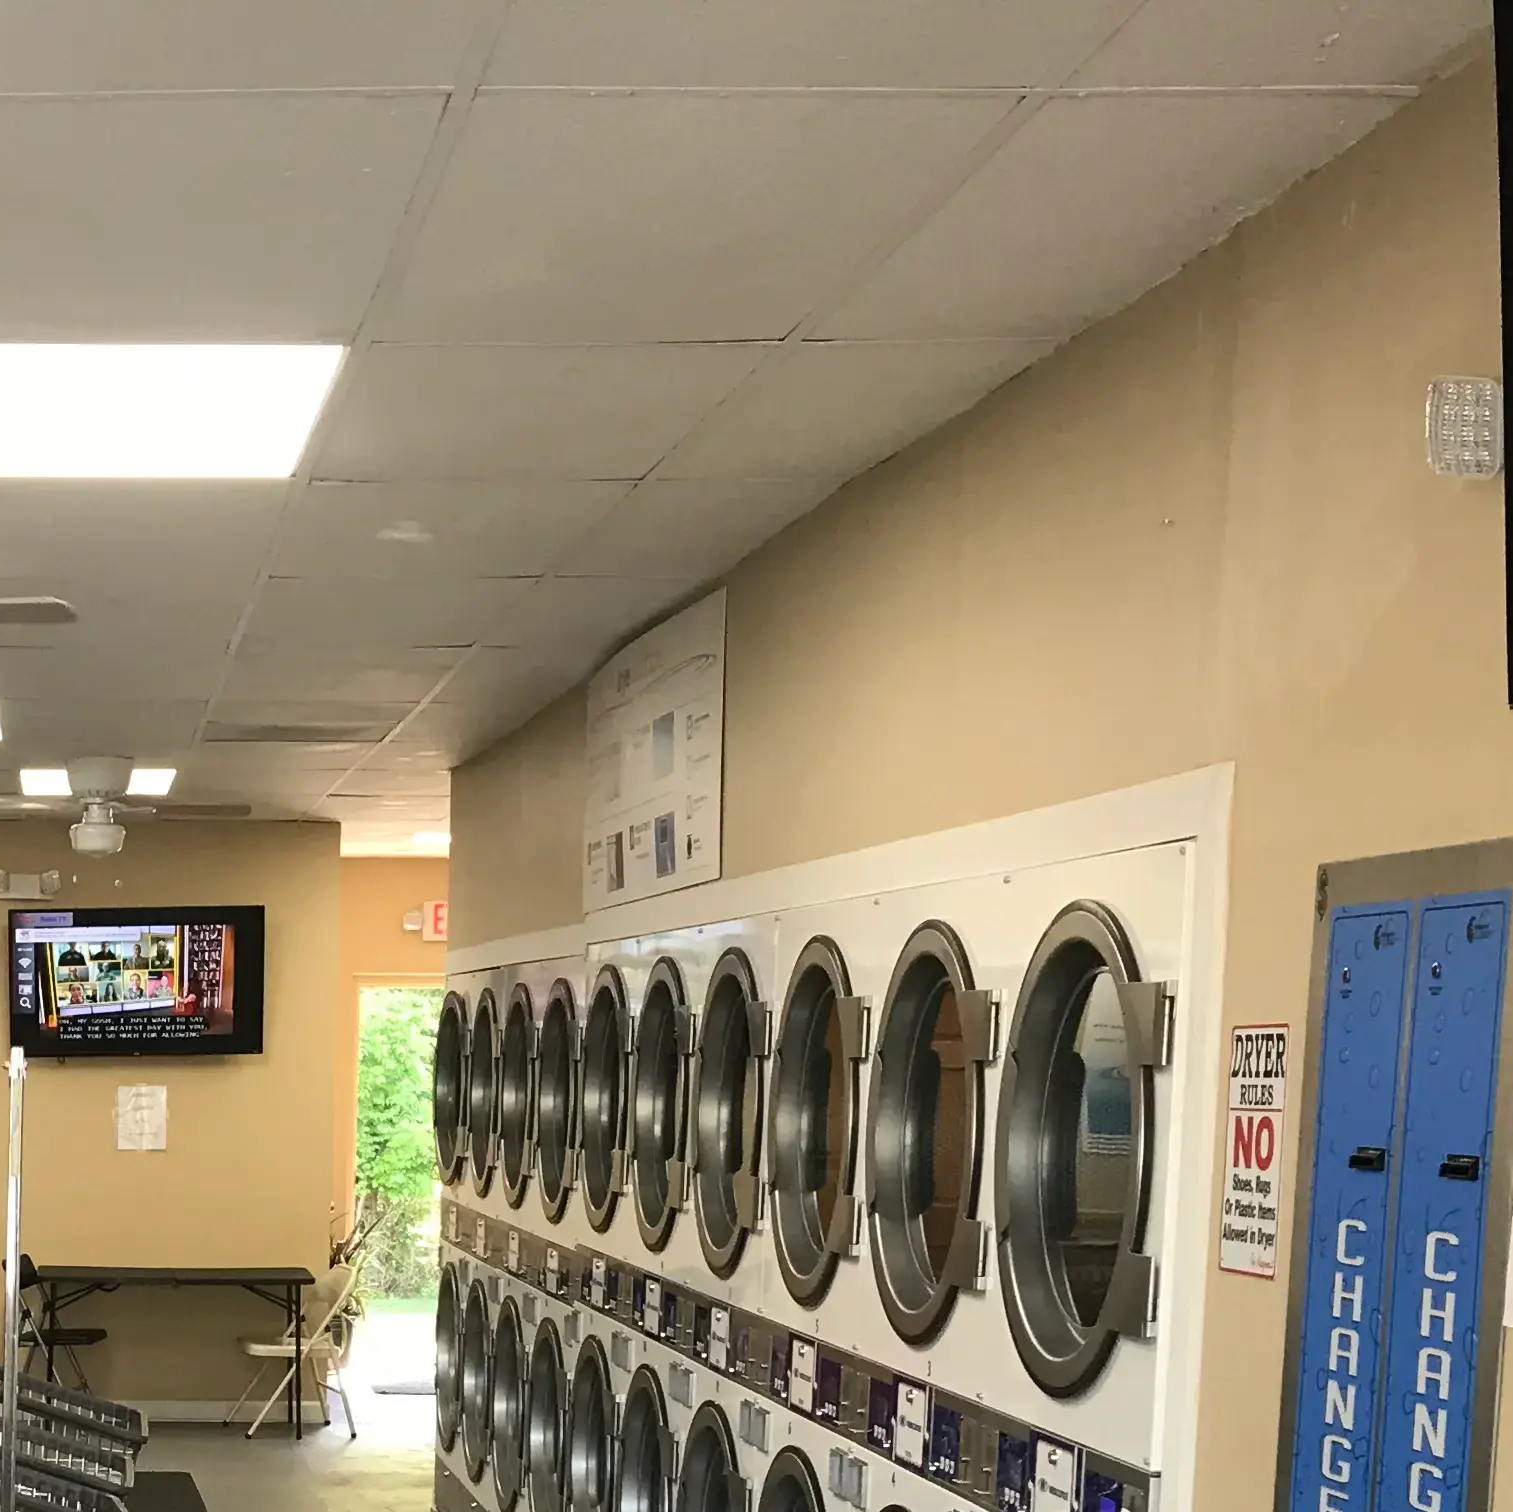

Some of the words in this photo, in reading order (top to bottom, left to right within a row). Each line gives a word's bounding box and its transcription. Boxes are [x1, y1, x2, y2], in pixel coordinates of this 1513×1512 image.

[1231, 1032, 1286, 1079] DRYER
[1239, 1084, 1275, 1106] RULES
[1233, 1115, 1275, 1171] NO
[1233, 1173, 1254, 1196] Shoes,
[1256, 1175, 1271, 1199] Rugs
[1225, 1198, 1233, 1215] Or
[1234, 1198, 1257, 1218] Plastic
[1258, 1202, 1276, 1221] Items
[1223, 1222, 1249, 1244] Allowed
[1250, 1225, 1256, 1244] in
[1257, 1227, 1276, 1251] Dryer
